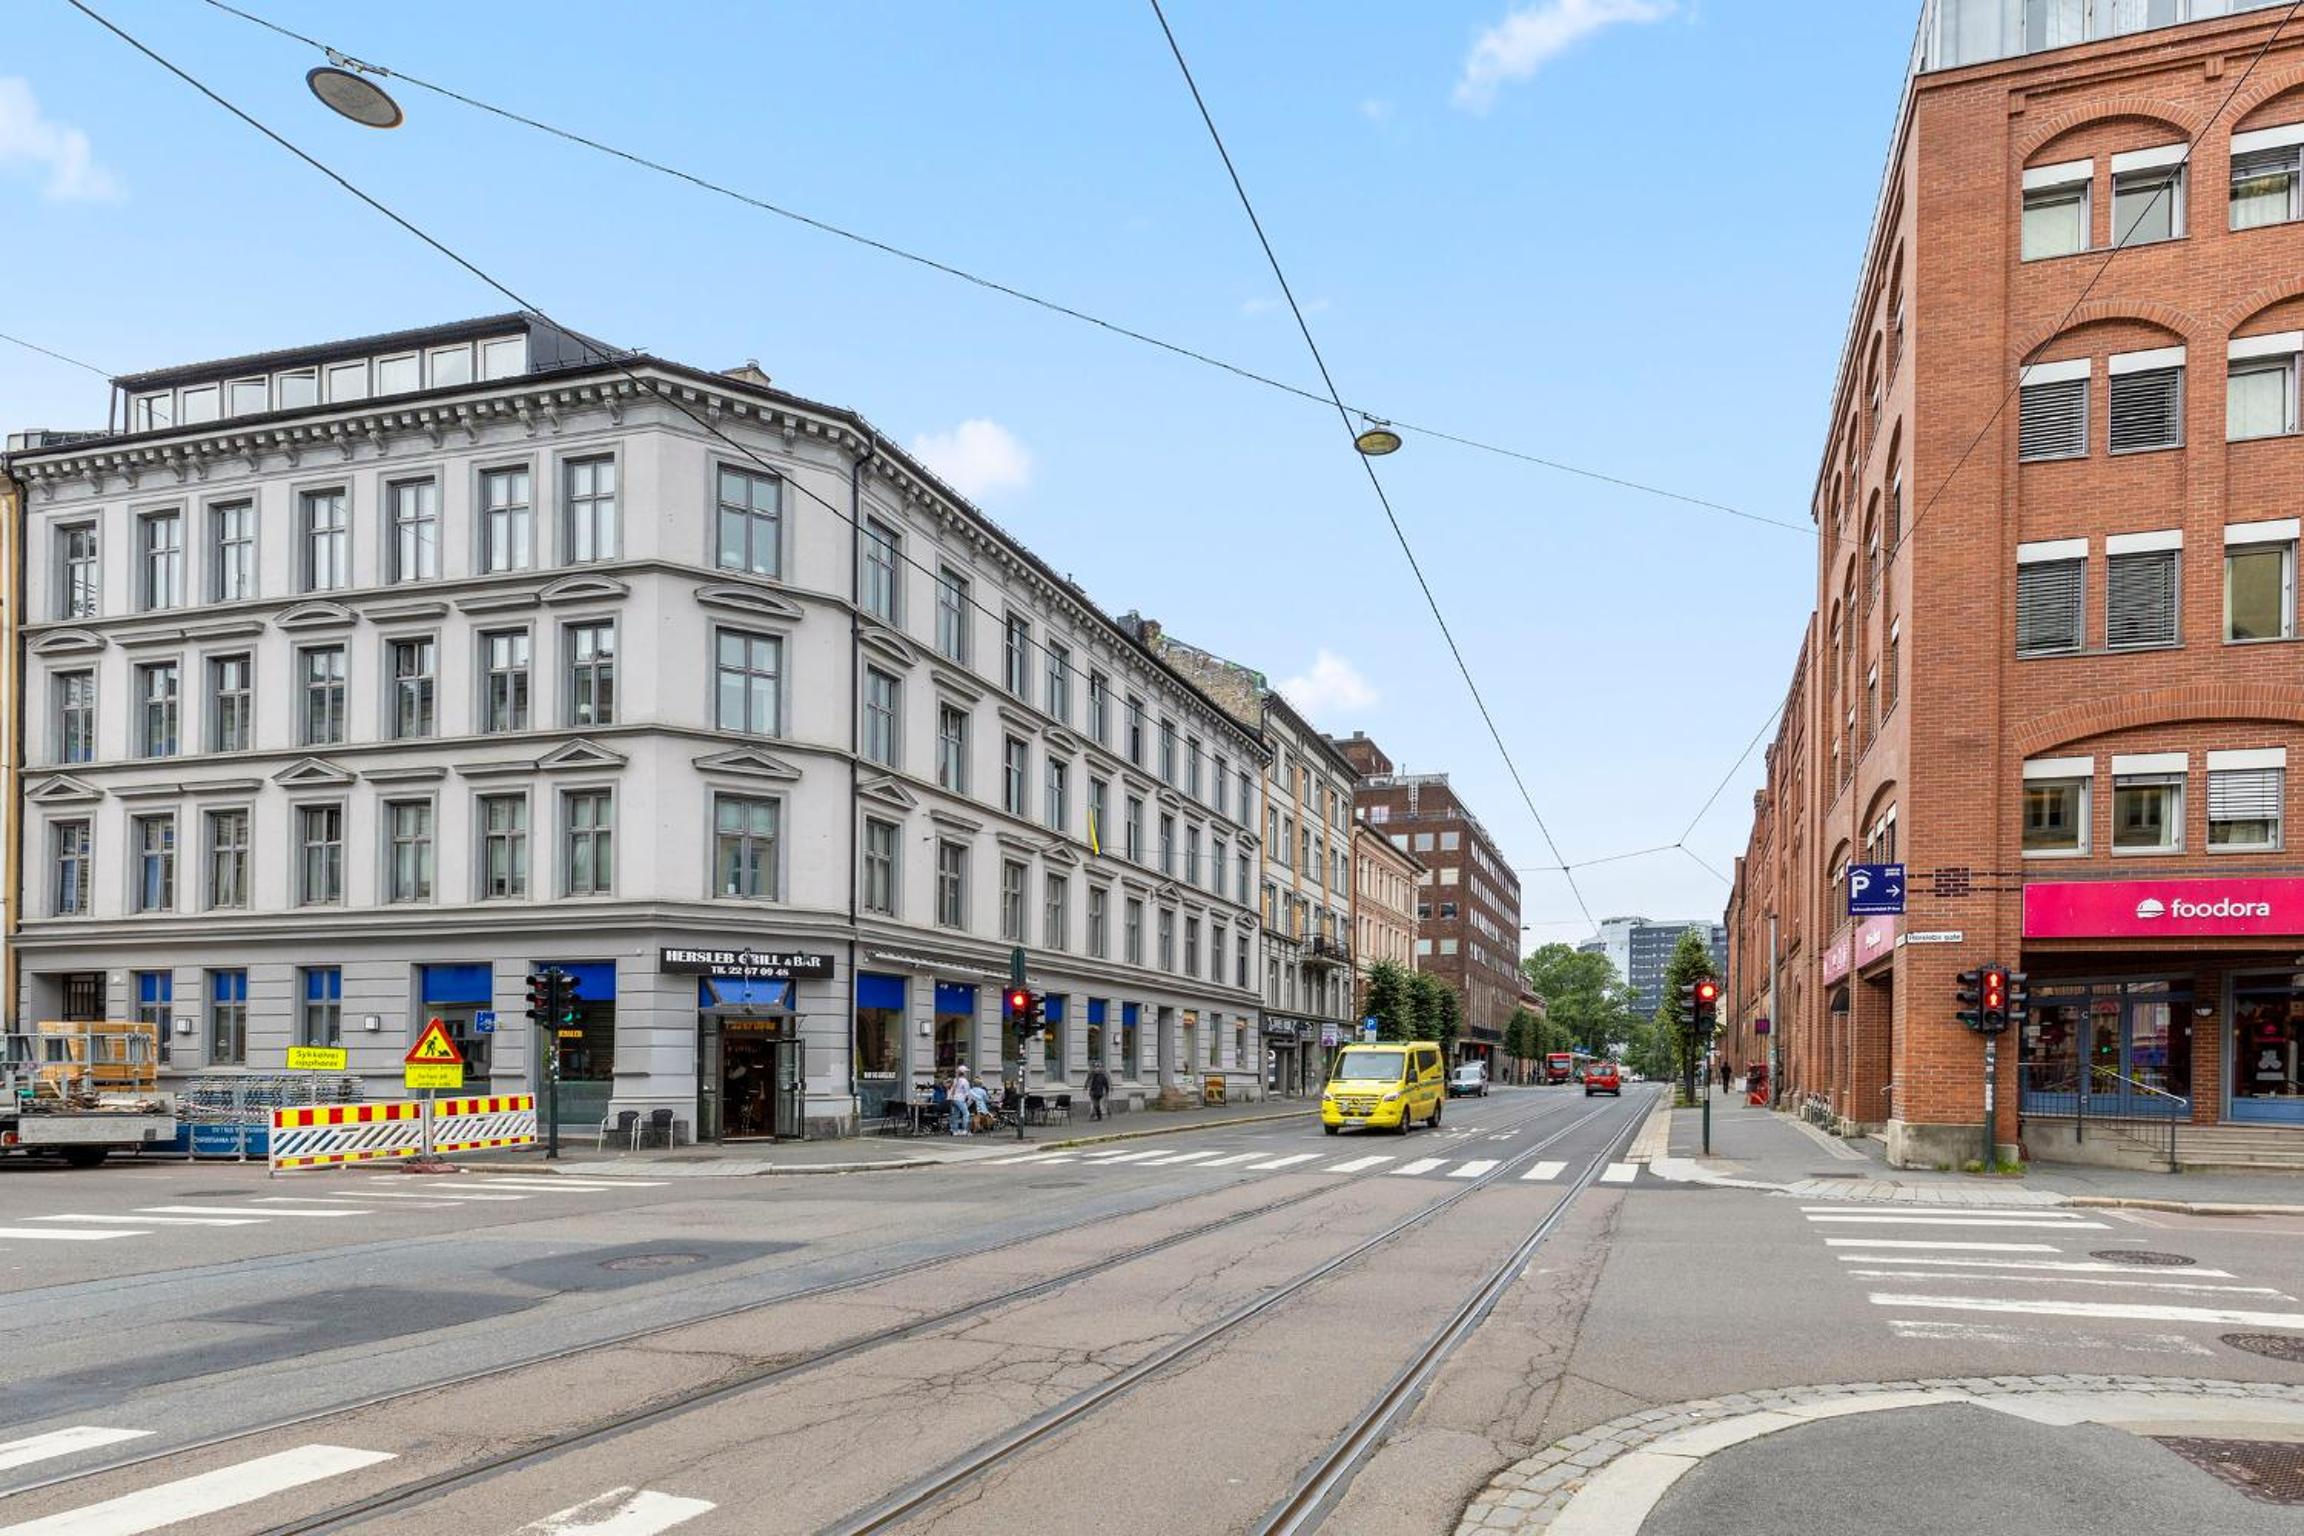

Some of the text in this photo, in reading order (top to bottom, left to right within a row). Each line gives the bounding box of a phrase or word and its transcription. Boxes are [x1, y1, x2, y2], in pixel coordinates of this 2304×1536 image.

[1851, 876, 1870, 898] P
[2171, 898, 2270, 918] foodora
[665, 950, 821, 968] HERSLEB GRILL & BAR
[728, 966, 742, 975] 22
[744, 967, 759, 975] 67
[760, 968, 774, 976] 09
[775, 968, 789, 976] 48
